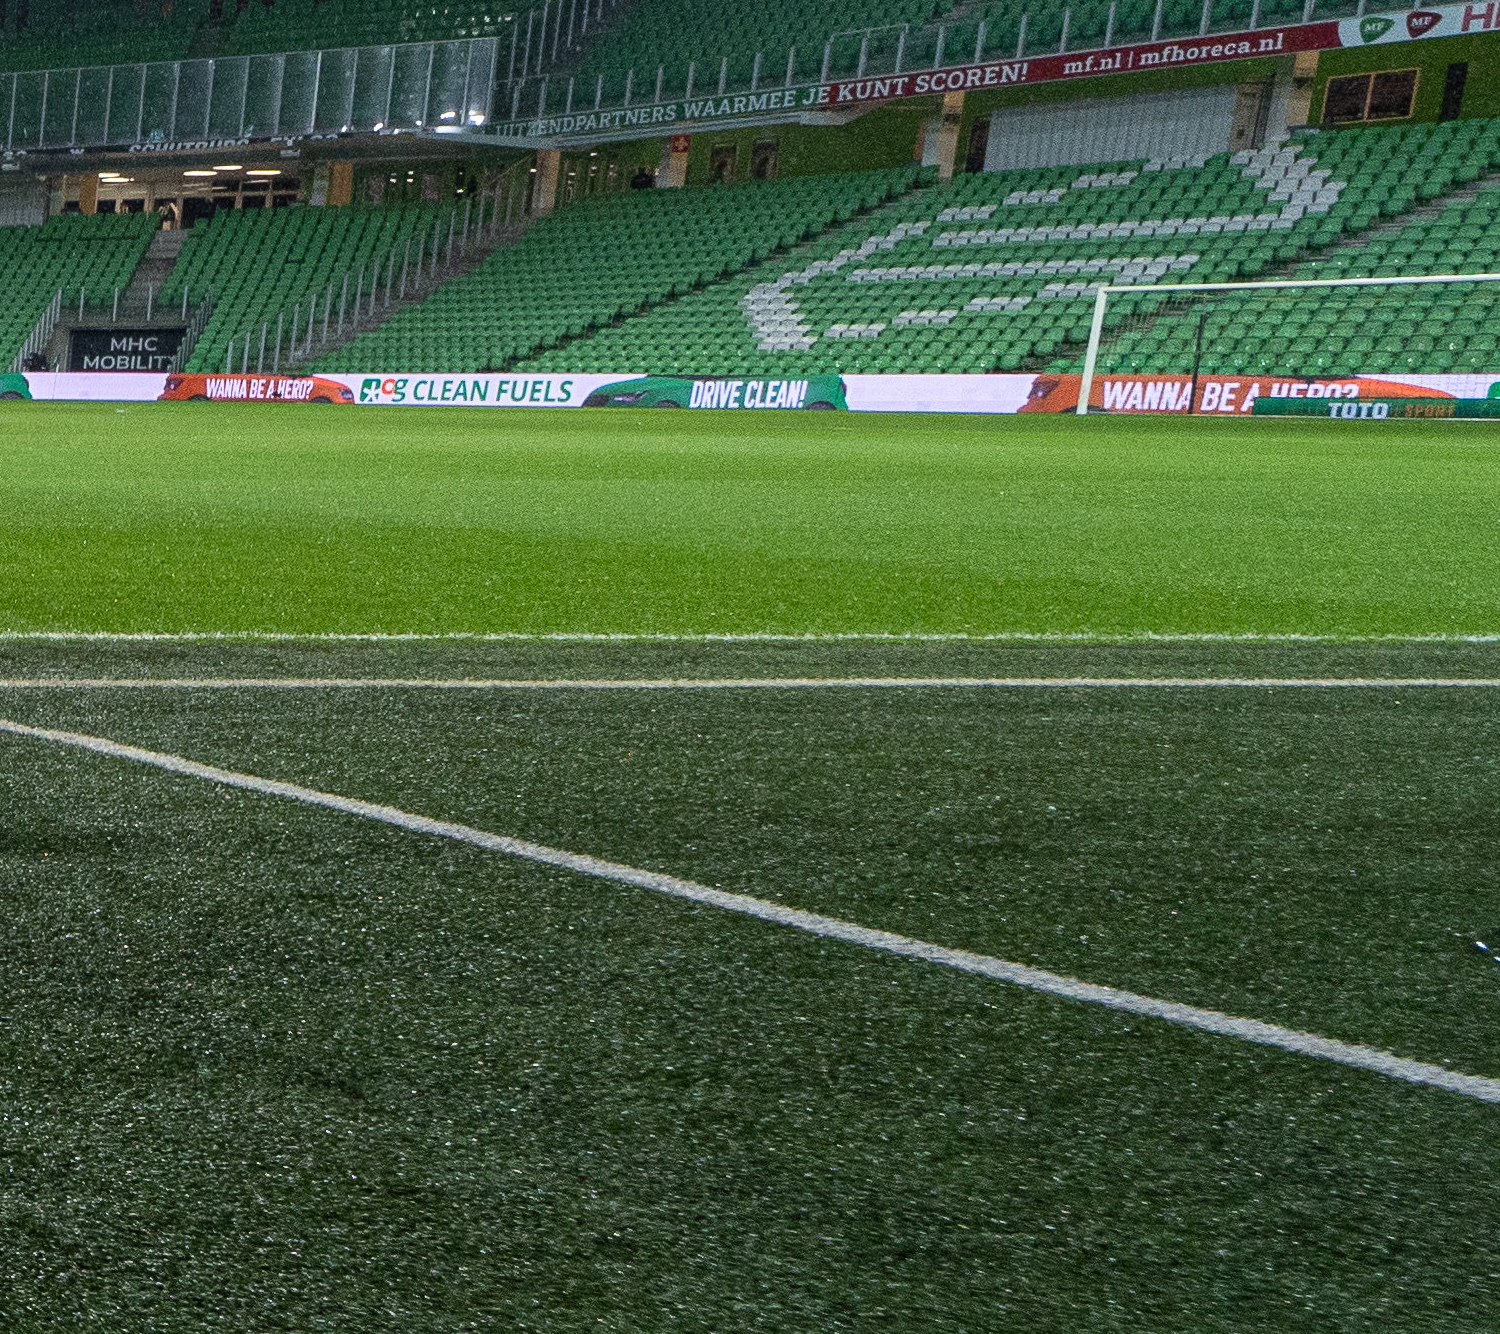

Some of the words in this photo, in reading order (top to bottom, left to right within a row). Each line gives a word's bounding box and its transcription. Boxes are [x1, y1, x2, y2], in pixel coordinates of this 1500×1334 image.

[1461, 2, 1500, 32] H
[1063, 52, 1122, 75] mf.nl
[1139, 32, 1285, 66] mfhoreca.nl
[495, 105, 677, 138] UITZENDPARTNERS
[683, 90, 797, 119] WAARMEE
[801, 86, 831, 106] JE
[835, 78, 910, 104] KUNT
[914, 63, 1030, 94] SCOREN!
[110, 337, 158, 351] MHC
[205, 378, 248, 399] WANNA
[249, 379, 266, 399] BE
[265, 379, 275, 399] A
[277, 379, 314, 400] HERO?
[412, 380, 490, 402] CLEAN
[496, 380, 573, 403] FUELS
[689, 380, 744, 409] DRIVE
[743, 379, 809, 409] CLEAN!
[1103, 381, 1194, 411] WANNA
[1200, 382, 1241, 411] BE
[1240, 382, 1261, 411] A
[1328, 402, 1389, 419] TOTO
